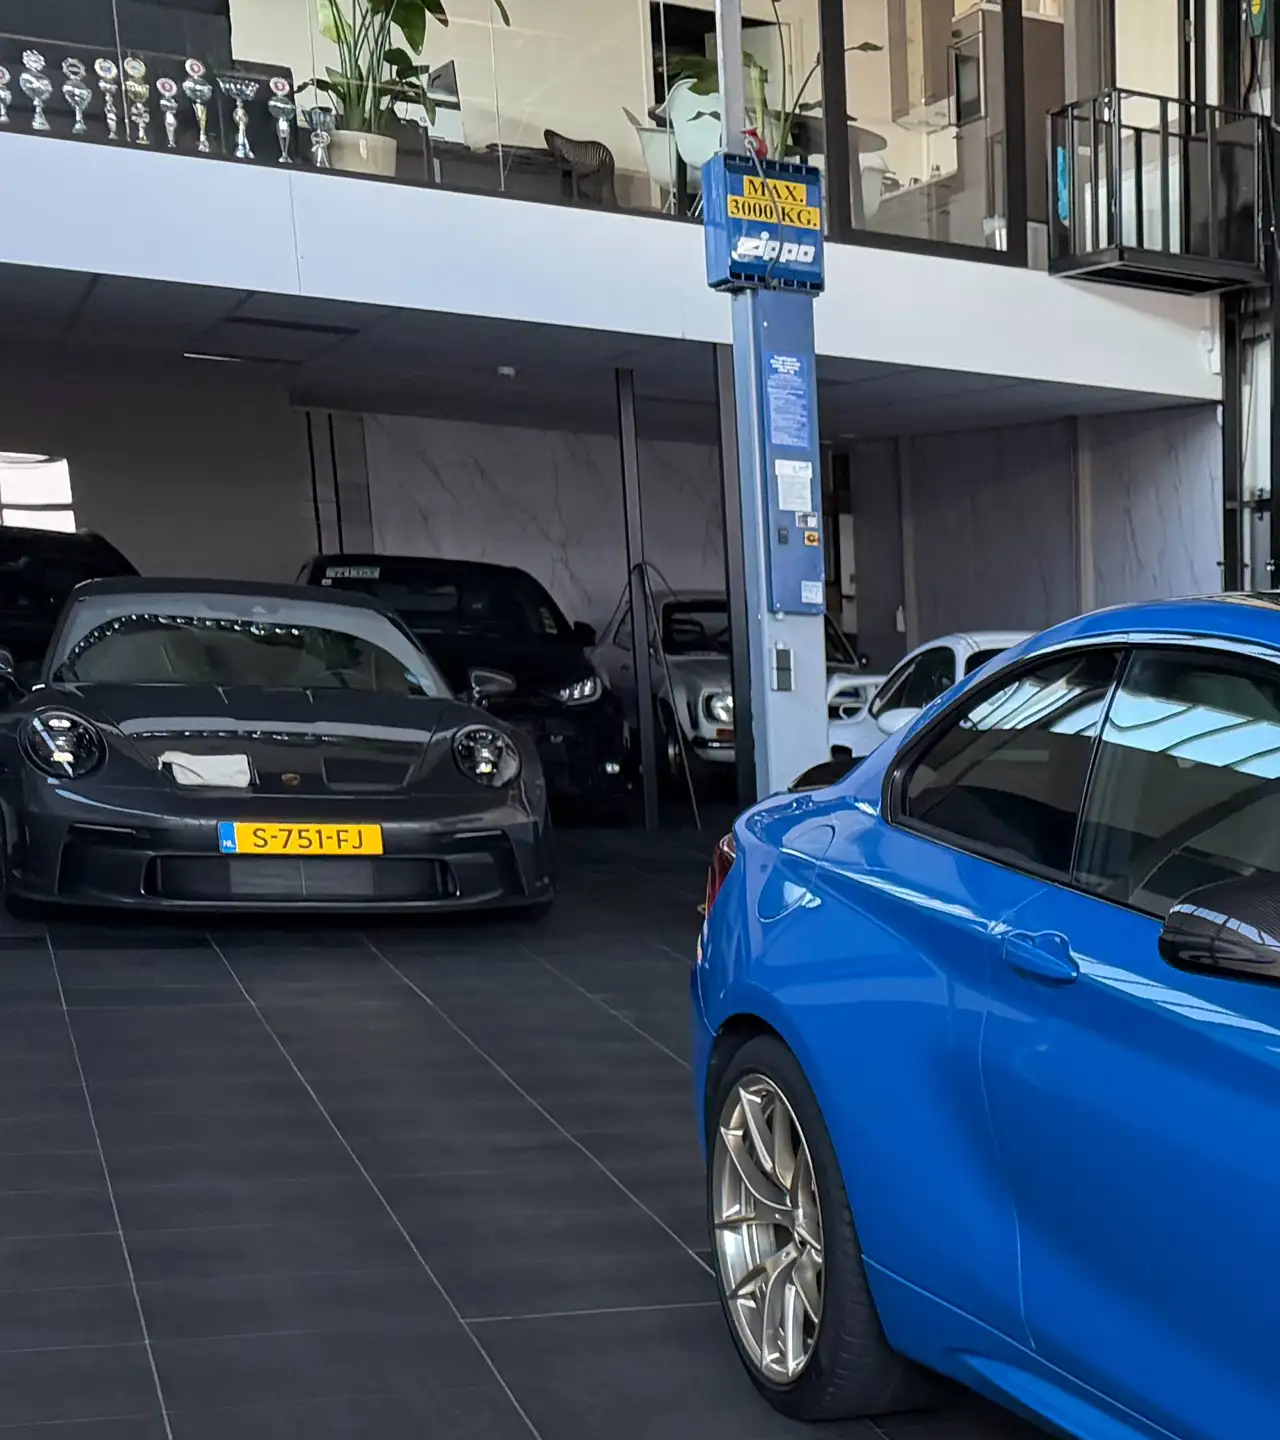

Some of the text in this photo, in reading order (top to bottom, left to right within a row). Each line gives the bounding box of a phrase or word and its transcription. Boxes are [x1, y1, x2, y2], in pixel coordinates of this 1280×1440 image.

[747, 178, 804, 203] MAX.
[730, 199, 818, 228] 3000 KG.
[252, 827, 363, 850] S-751-FJ
